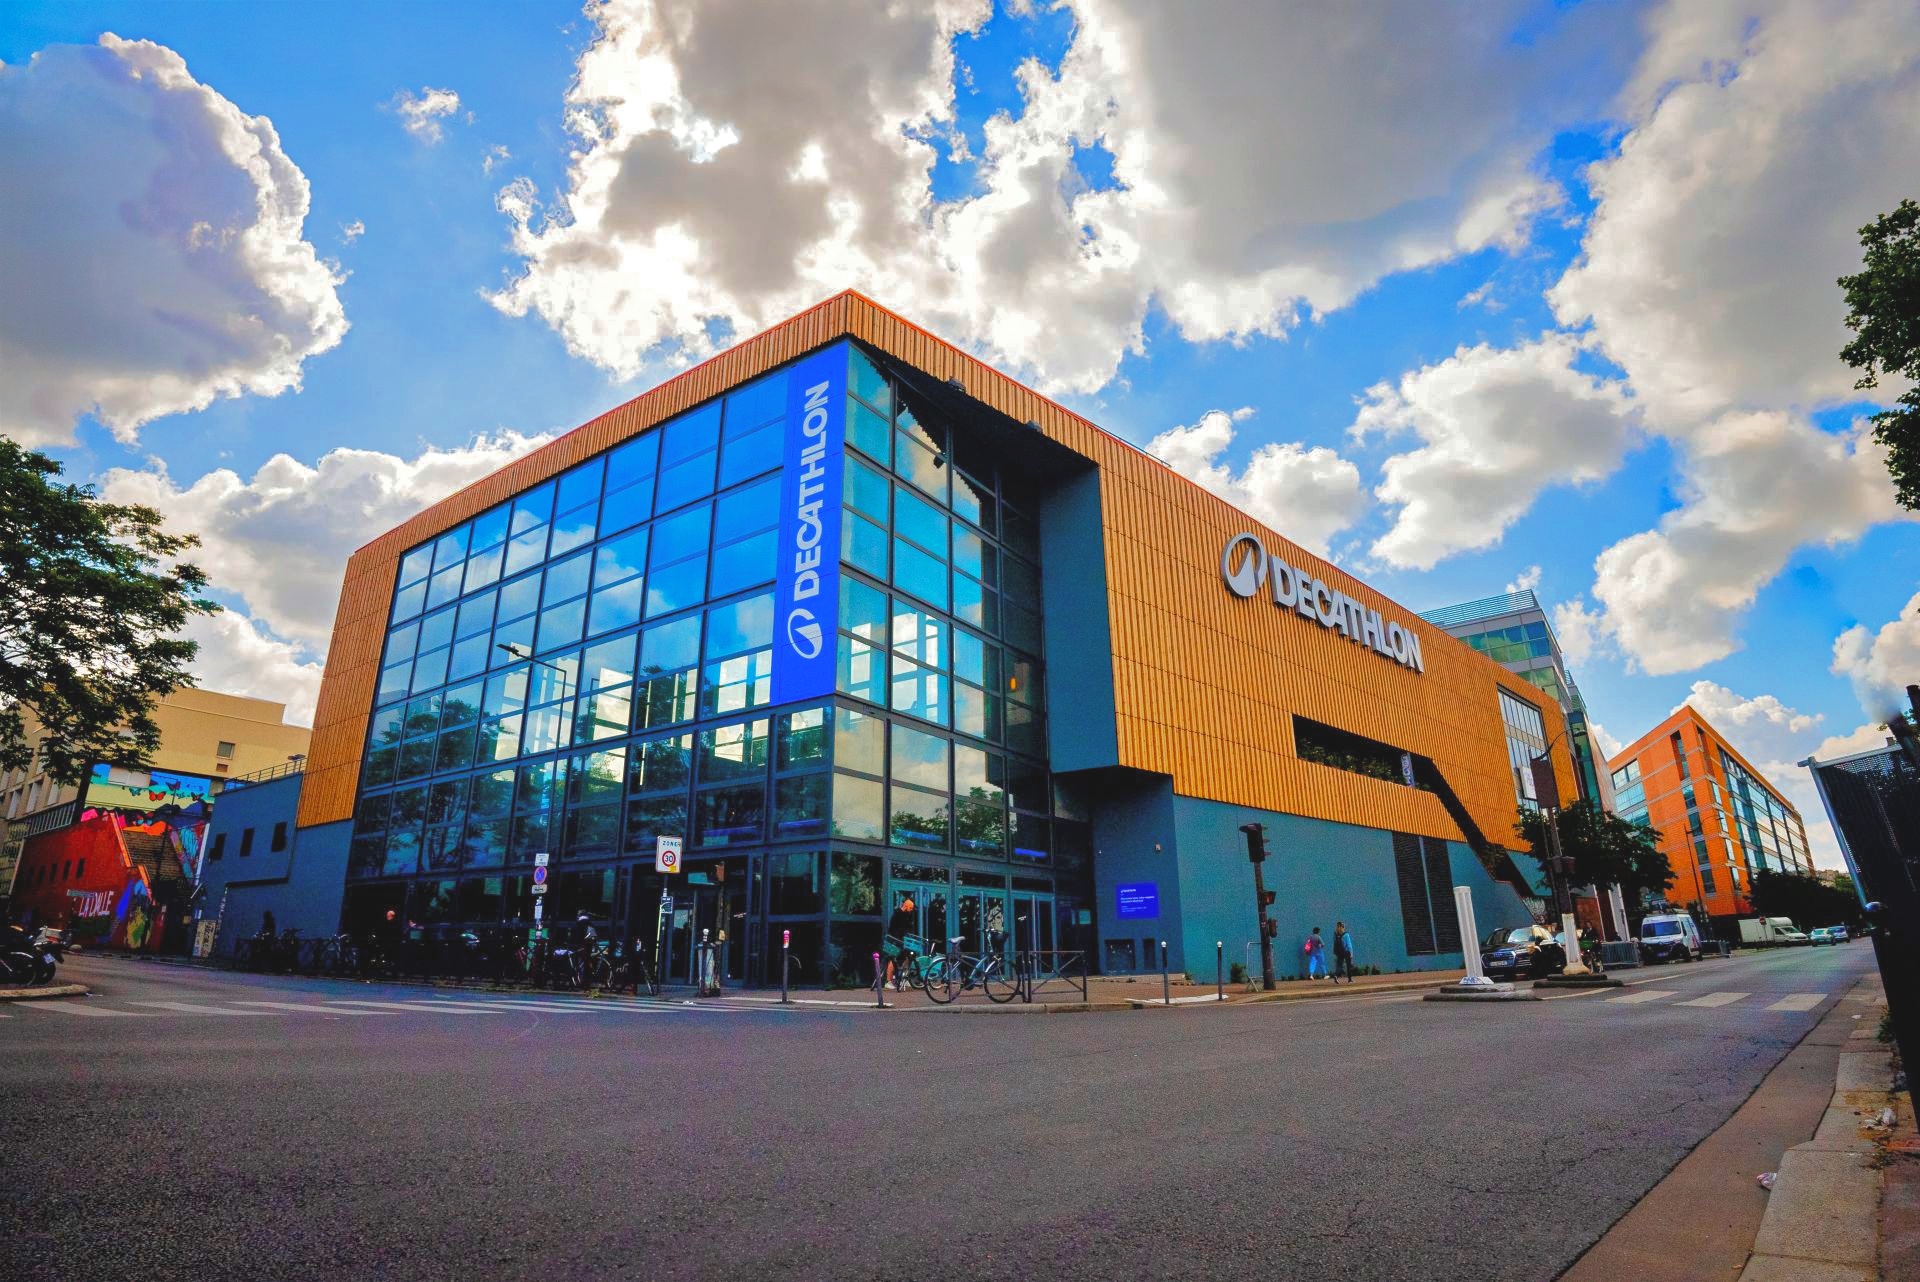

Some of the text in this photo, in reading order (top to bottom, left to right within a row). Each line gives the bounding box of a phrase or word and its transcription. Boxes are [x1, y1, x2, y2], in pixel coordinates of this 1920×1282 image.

[793, 380, 830, 602] DECATHLON
[1268, 554, 1425, 674] DECATHLON
[664, 854, 674, 863] 30
